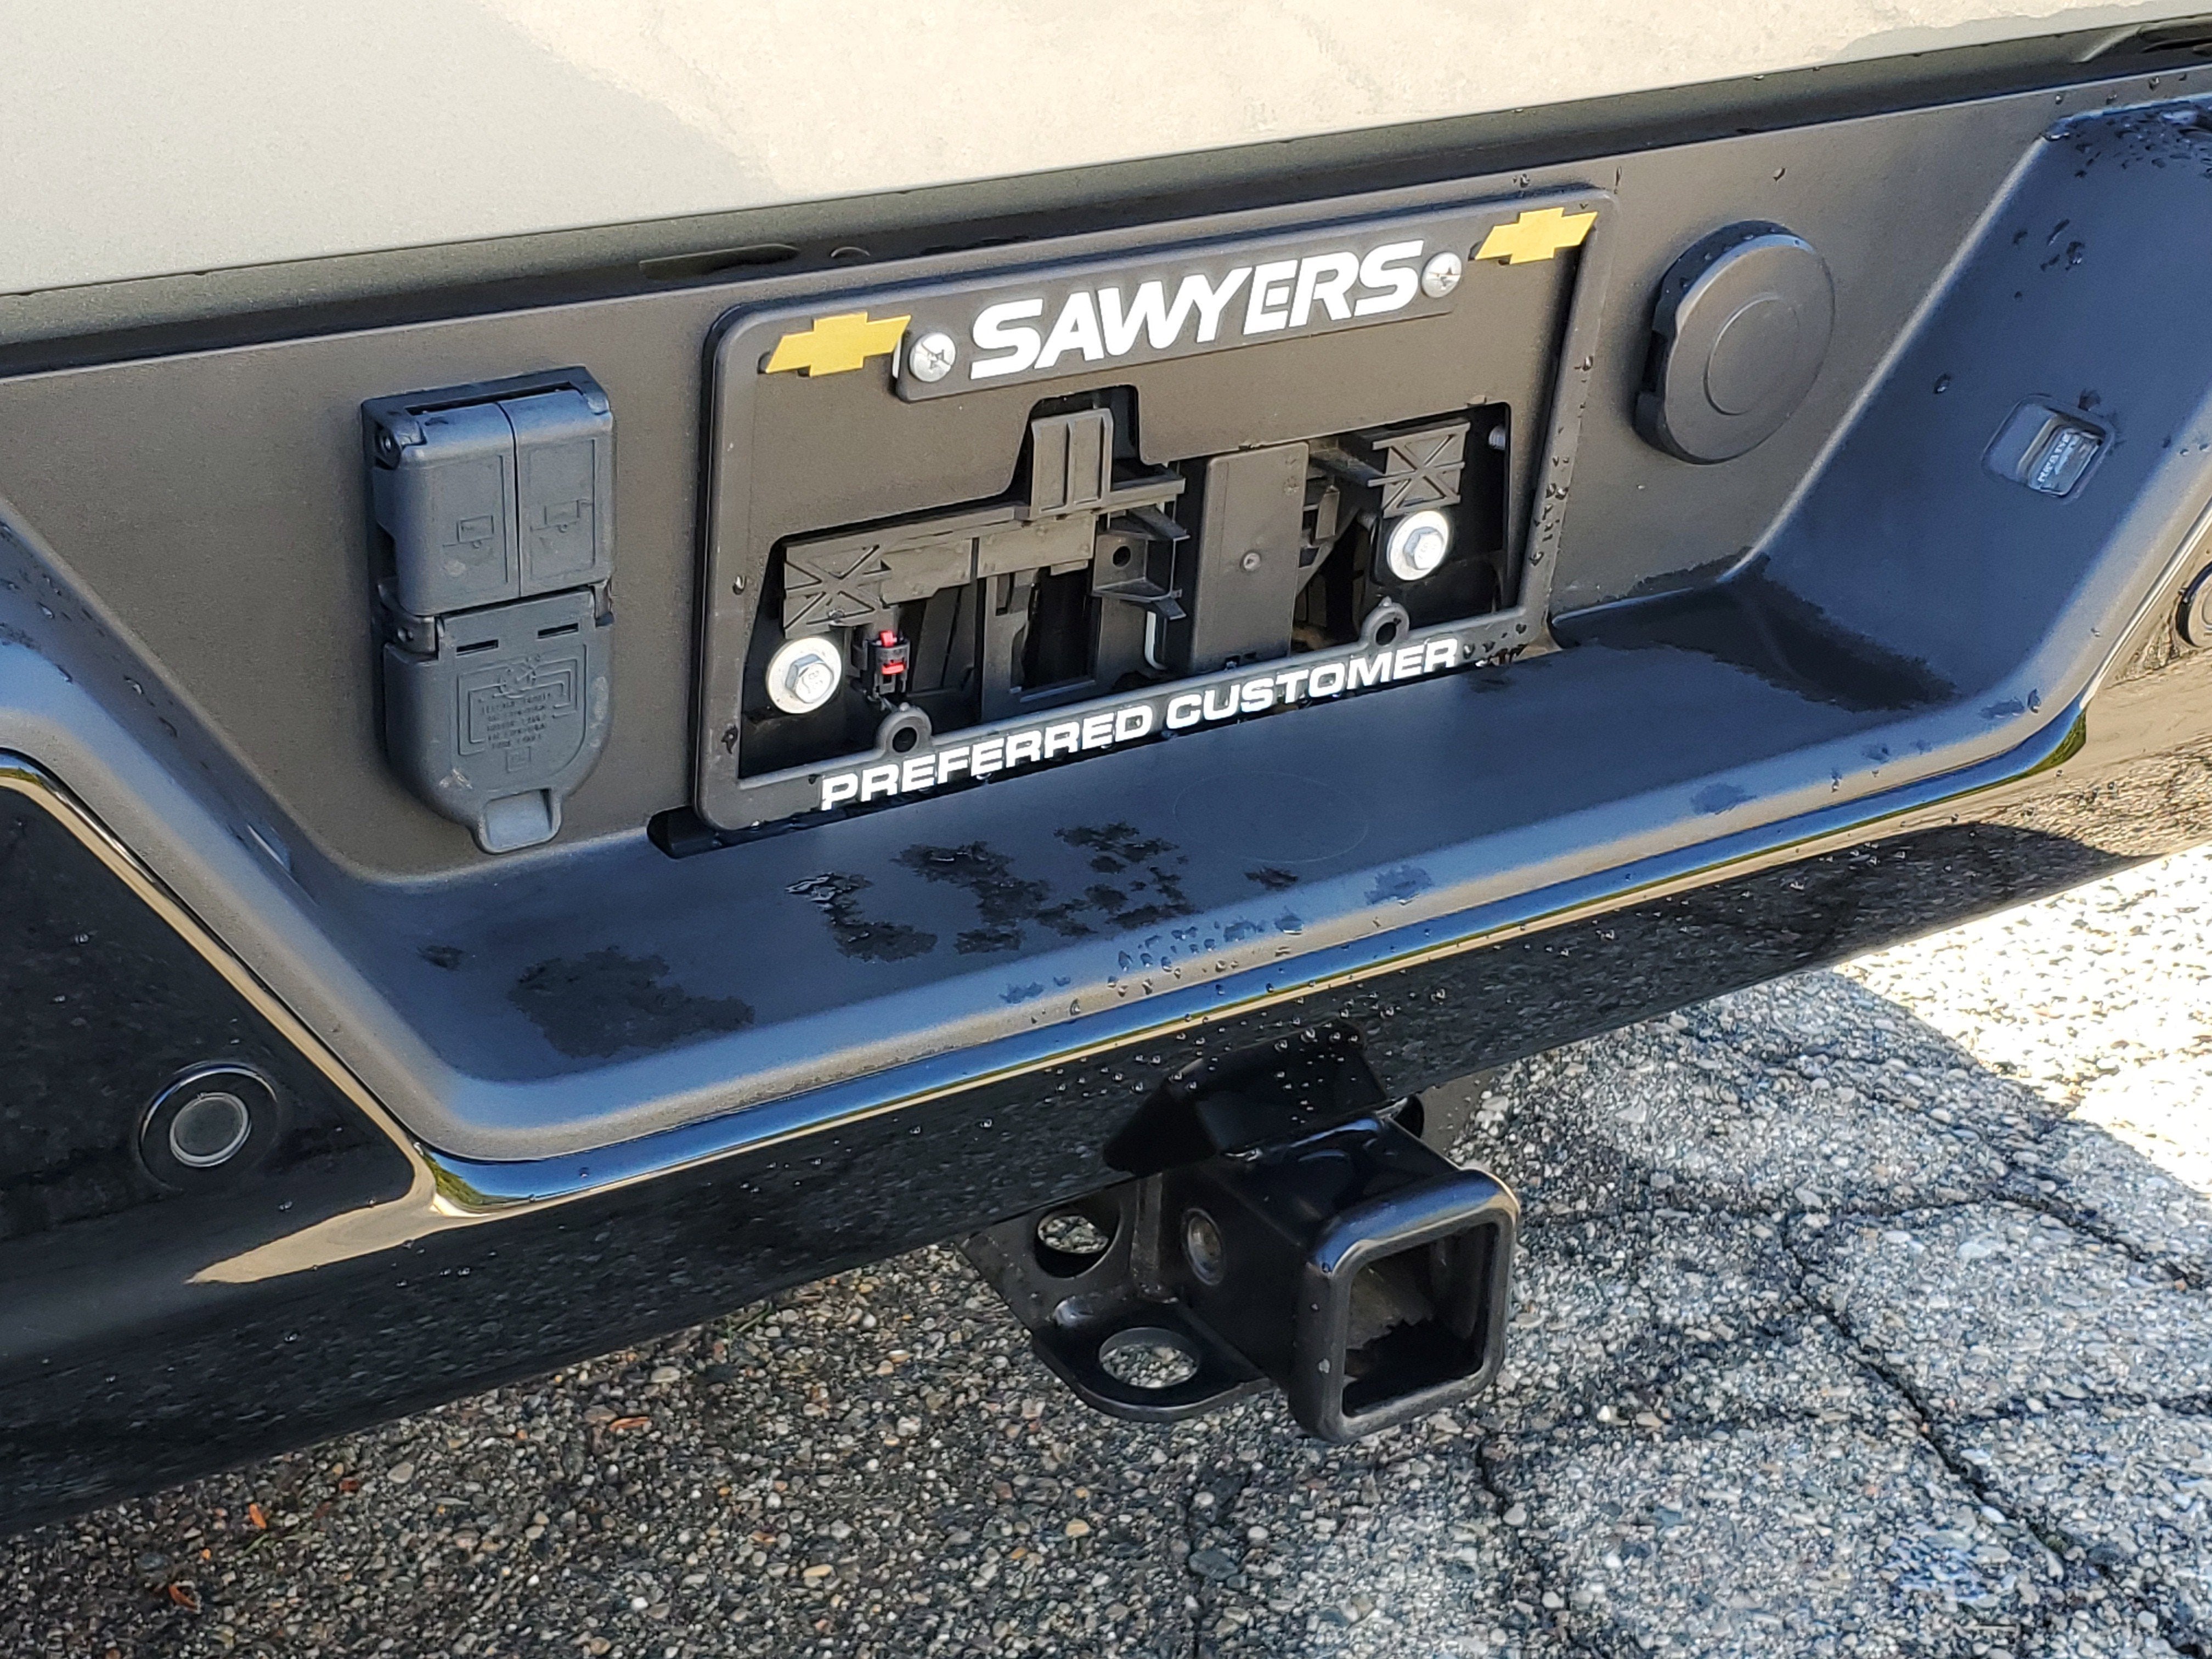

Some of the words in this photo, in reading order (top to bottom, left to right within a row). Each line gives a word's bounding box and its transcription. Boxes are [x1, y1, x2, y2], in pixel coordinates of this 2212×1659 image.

[970, 240, 1425, 379] SAWYERS
[821, 705, 1153, 810] PREFERRED
[1166, 639, 1458, 729] CUSTOMER
